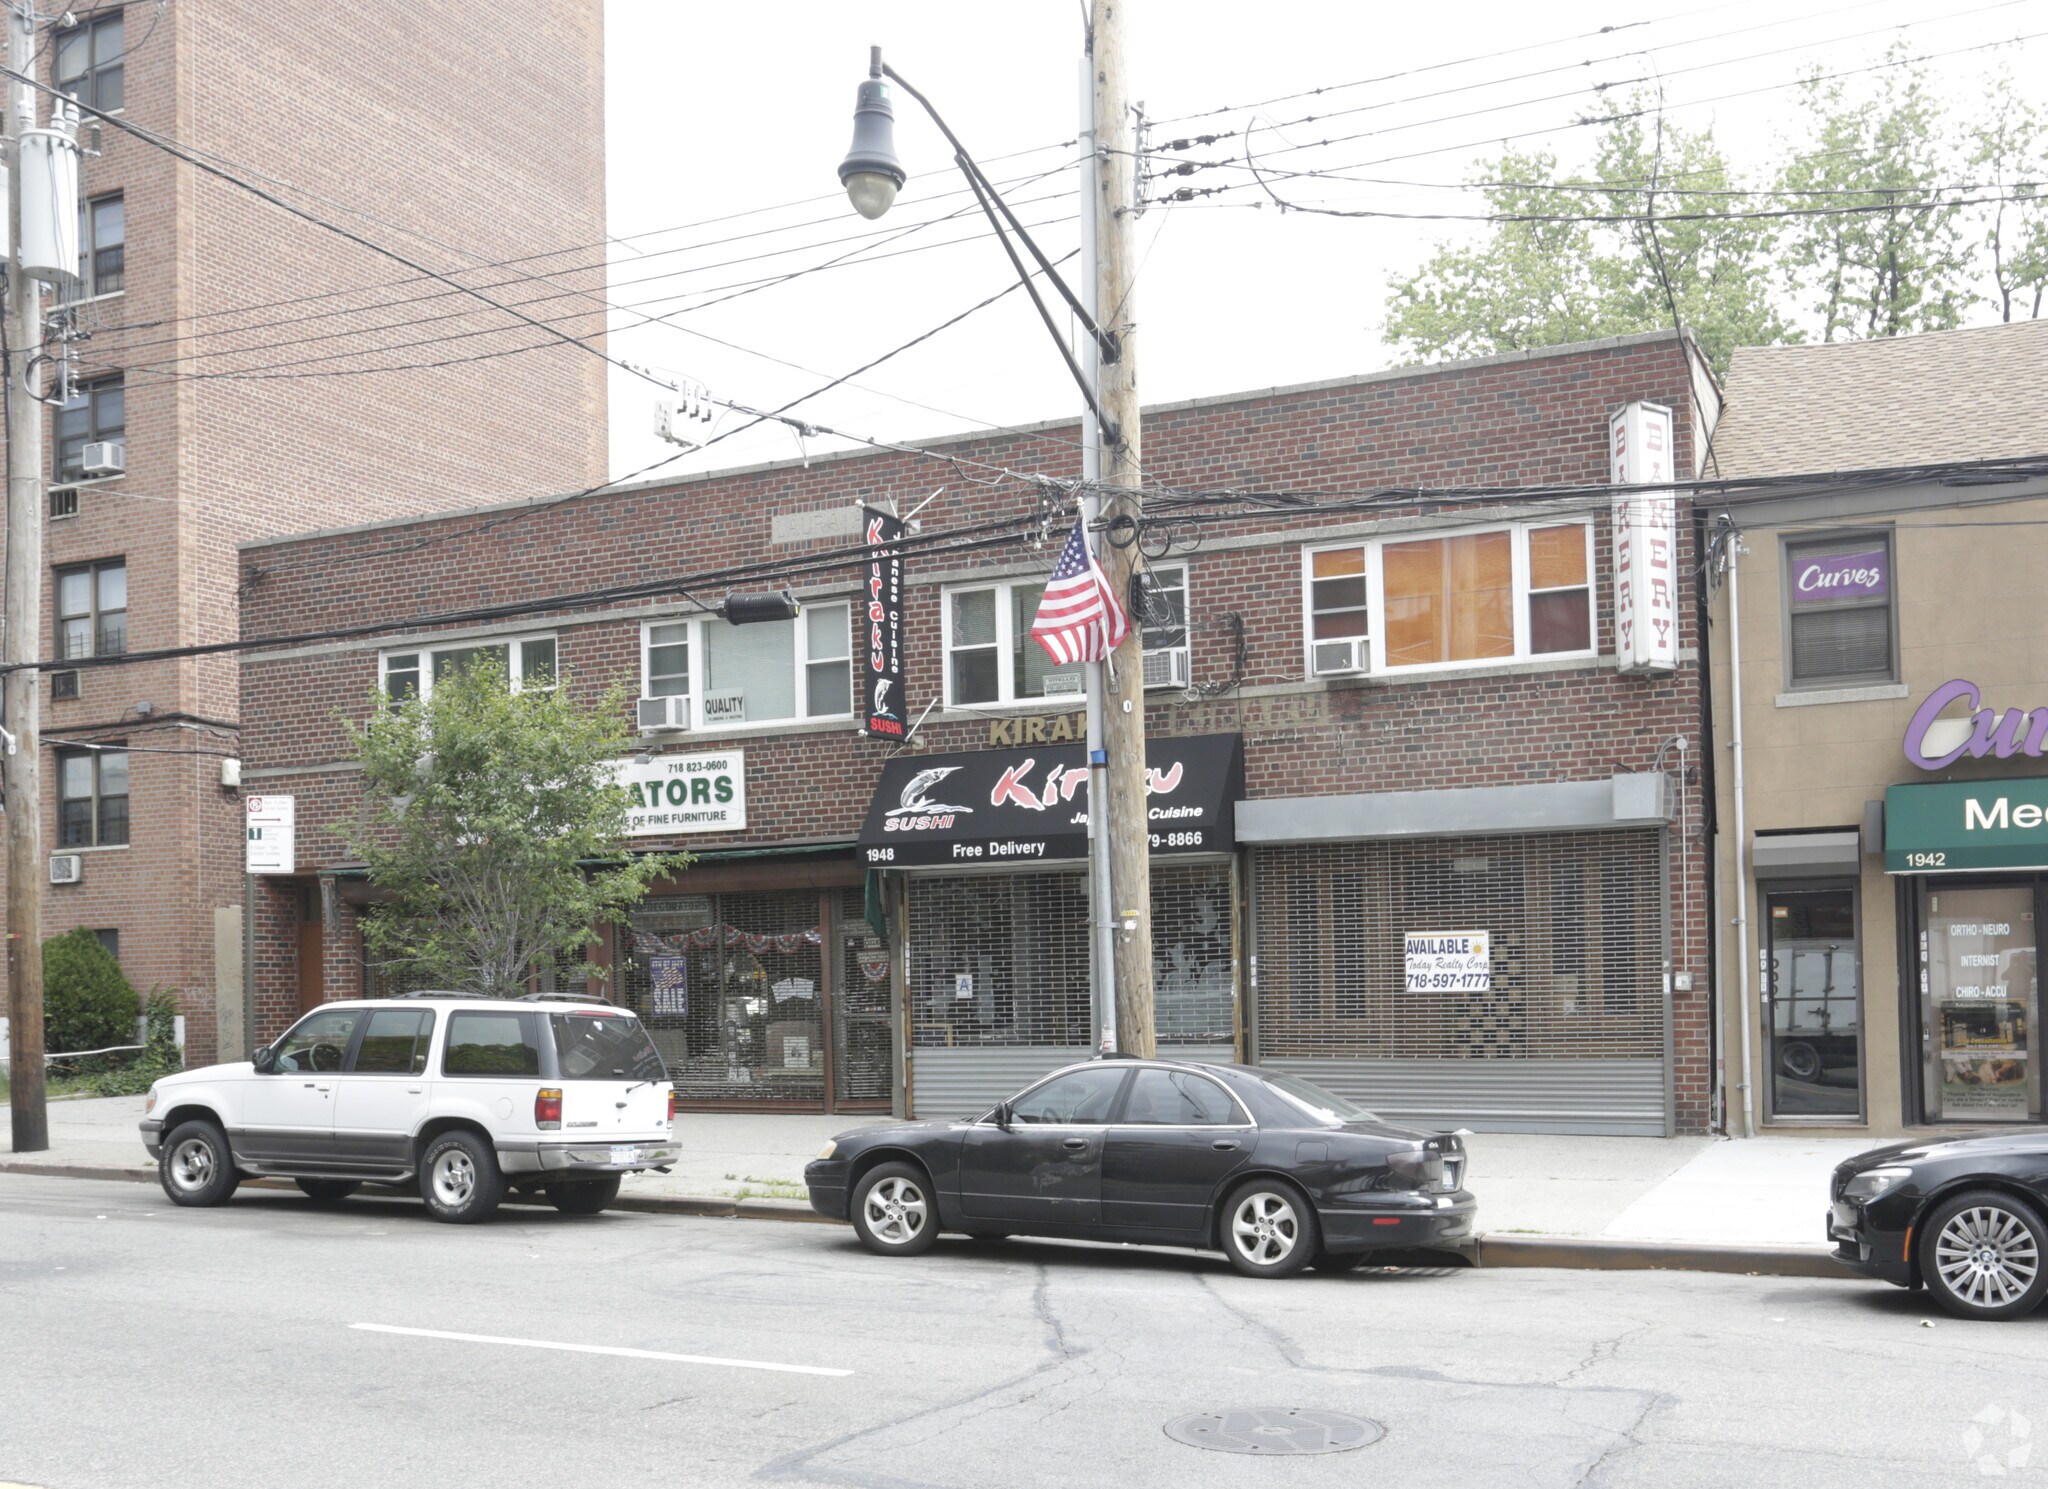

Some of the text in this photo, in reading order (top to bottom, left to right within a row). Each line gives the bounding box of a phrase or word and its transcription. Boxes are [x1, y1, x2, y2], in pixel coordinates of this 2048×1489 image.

[1615, 424, 1633, 651] BAKERY
[1646, 422, 1671, 649] BAKERY
[1799, 565, 1881, 591] Curves
[867, 517, 889, 672] Kiraku
[889, 532, 901, 673] Jpanese Cuisine
[705, 696, 744, 715] QUALITY
[870, 717, 903, 735] SUSHI
[668, 760, 728, 773] 718 823-0600
[614, 775, 734, 808] ATORS
[991, 758, 1184, 811] Kiru
[633, 816, 645, 825] OF
[648, 814, 669, 824] FINE
[671, 811, 727, 822] FURNITURE
[1148, 806, 1204, 820] Cuisine
[1965, 797, 2048, 830] Me
[884, 815, 955, 832] SUSHI
[866, 848, 895, 862] 1948
[952, 841, 1046, 858] Free Delivery
[1906, 853, 1946, 866] 1942
[1951, 924, 1977, 936] ORTHO
[1982, 923, 2010, 935] NEURO
[1406, 938, 1469, 955] AVAILABLE
[1407, 957, 1432, 972] Today
[1435, 957, 1463, 972] Realty
[1961, 954, 2000, 967] INTERNIST
[959, 977, 970, 991] A
[1407, 973, 1489, 988] 718-597-1777
[1956, 986, 1979, 998] CHIRO
[1985, 985, 2007, 997] ACCU
